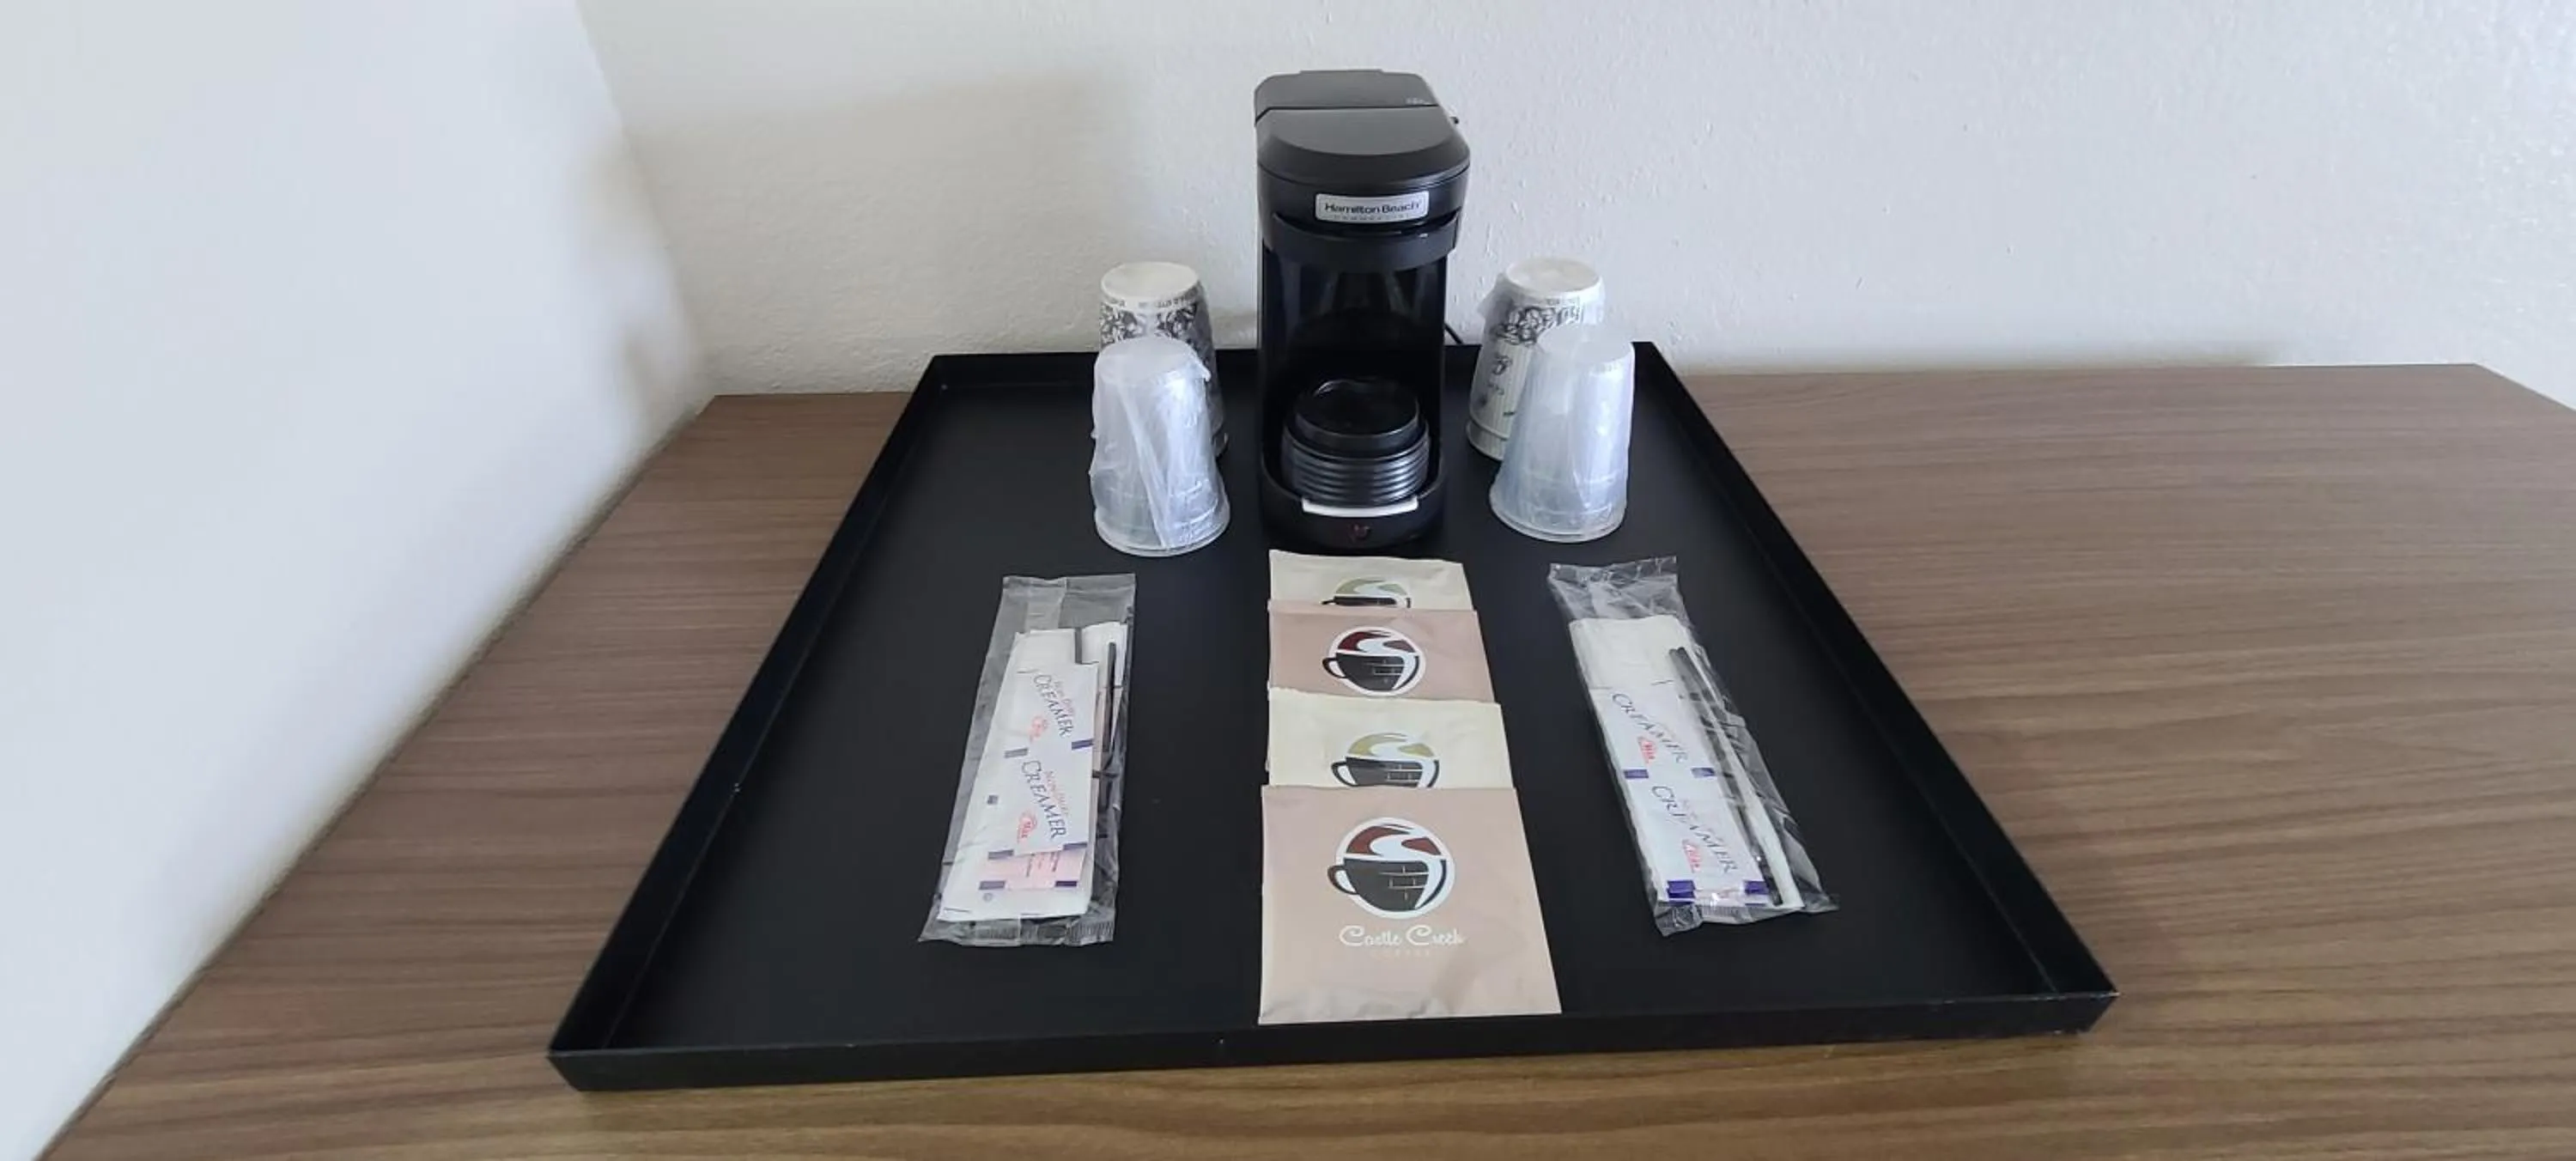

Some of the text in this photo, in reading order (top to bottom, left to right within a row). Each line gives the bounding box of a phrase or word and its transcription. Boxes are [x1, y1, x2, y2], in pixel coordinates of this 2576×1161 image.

[1324, 200, 1420, 215] Hamilton Beach
[1021, 760, 1066, 841] CREAMER
